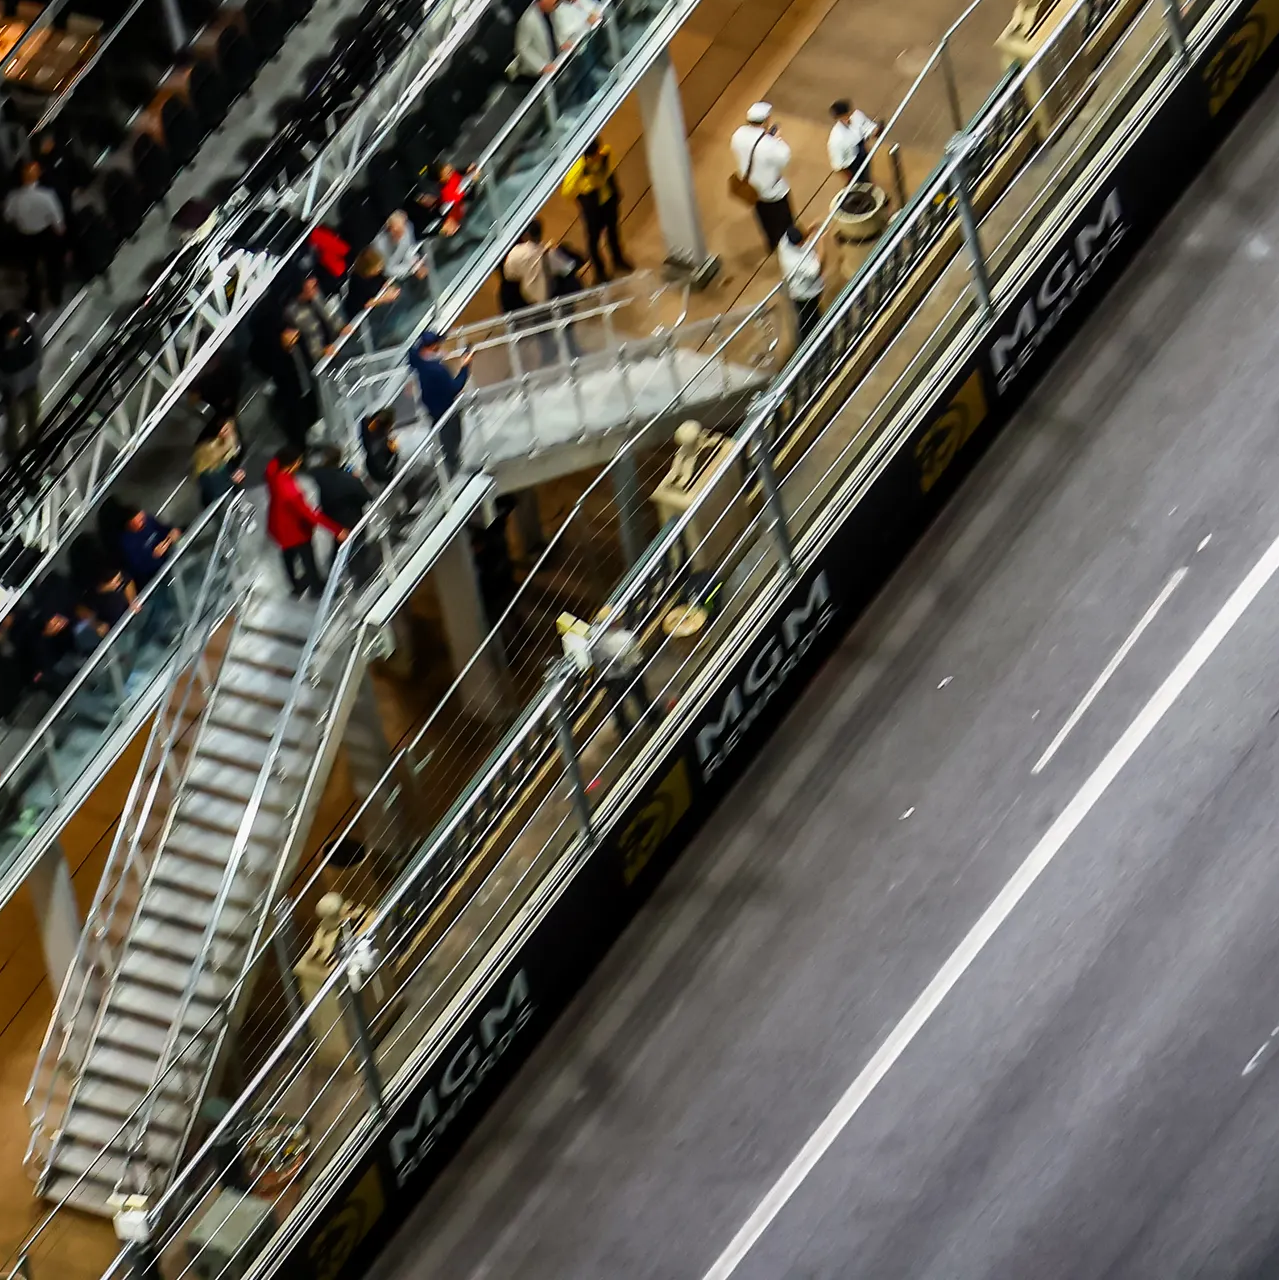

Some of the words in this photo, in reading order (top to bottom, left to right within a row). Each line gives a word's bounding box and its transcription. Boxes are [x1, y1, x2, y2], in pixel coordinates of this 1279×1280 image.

[989, 186, 1122, 374] MGM
[996, 218, 1132, 394] REWARDS
[693, 569, 830, 766] MGM
[702, 602, 840, 785] REWARDS
[390, 968, 530, 1172] MGM
[397, 992, 542, 1191] REWARDS
